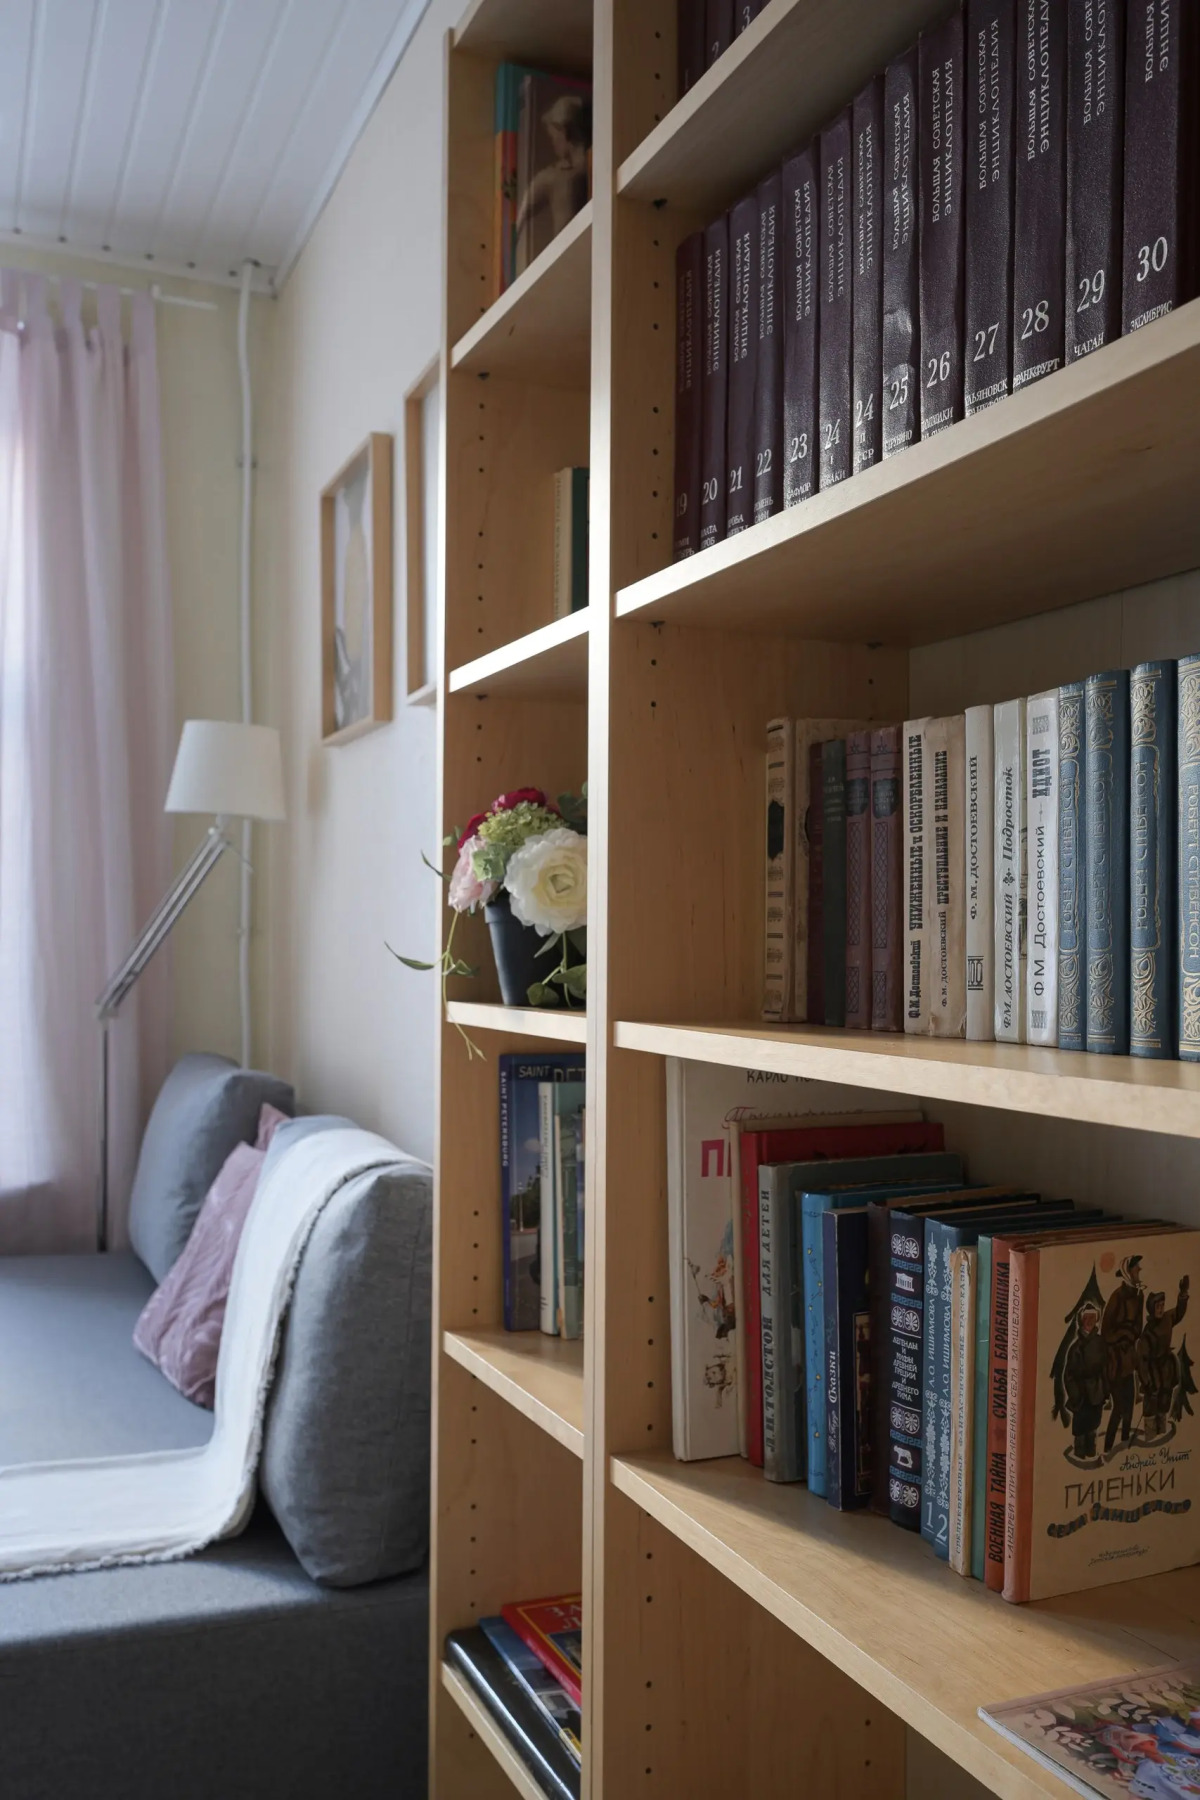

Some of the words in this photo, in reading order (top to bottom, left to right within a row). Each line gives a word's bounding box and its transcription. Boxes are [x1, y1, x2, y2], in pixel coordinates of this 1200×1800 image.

[978, 29, 987, 113] СОВЕТСКАЯ
[1145, 1, 1155, 83] БОЛЬШАЯ
[932, 67, 941, 149] СОВЕТСКАЯ
[990, 18, 1001, 182] ЭНЦИКЛОПЕДИЯ
[1083, 49, 1093, 125] БОЛЬШАЯ
[893, 102, 901, 181] СОВЕТСКАЯ
[944, 58, 953, 217] ЭНЦИКЛОПЕДИЯ
[978, 121, 988, 190] БОЛЬШАЯ
[1027, 88, 1036, 161] БОЛЬШАЯ
[858, 131, 866, 208] СОВЕТСКАЯ
[866, 122, 874, 269] ЭНЦИКЛОПЕДИЯ
[901, 92, 911, 245] ЭНЦИКЛОПЕДИЯ
[931, 156, 942, 223] БОЛЬШАЯ
[795, 189, 803, 258] СОВЕТСКАЯ
[827, 165, 835, 237] СОВЕТСКАЯ
[837, 157, 845, 297] ЭНЦИКЛОПЕДИЯ
[892, 187, 900, 251] БОЛЬШАЯ
[735, 238, 743, 304] СОВЕТСКАЯ
[760, 211, 768, 279] СОВЕТСКАЯ
[766, 205, 776, 335] ЭНЦИКЛОПЕДИЯ
[803, 181, 812, 317] ЭНЦИКЛОПЕДИЯ
[827, 243, 835, 303] БОЛЬШАЯ
[1136, 235, 1168, 281] 30
[712, 248, 721, 372] ЭНЦИКЛОПЕДИЯ
[740, 232, 751, 359] ЭНЦИКЛОПЕДИЯ
[1021, 300, 1050, 340] 28
[1076, 269, 1105, 313] 29
[926, 351, 950, 389] 26
[973, 323, 1000, 362] 27
[1074, 332, 1105, 357] ЧАГАН
[856, 393, 874, 428] 24
[890, 375, 909, 410] 25
[756, 449, 772, 478] 22
[790, 433, 808, 463] 23
[825, 419, 841, 450] 24
[703, 478, 718, 505] 20
[729, 466, 743, 493] 21
[908, 734, 923, 834] ОСКОРБЛЕННЫЕ
[935, 750, 948, 811] НАКАЗАНИЕ
[1031, 749, 1052, 799] ИДИОТ
[935, 814, 948, 823] И
[968, 755, 978, 879] ДОСТОЕВСКИЙ
[1002, 766, 1014, 862] Подросток
[1062, 776, 1074, 870] СТИВЕНСОН
[1134, 761, 1148, 862] СТИВЕНСОН
[1187, 784, 1199, 849] РОБЕРТ
[909, 846, 923, 931] УНИЖЕННЫЕ
[935, 826, 949, 905] ПРЕСТУПЛЕНИЕ
[1034, 825, 1047, 949] Достоевский
[969, 903, 978, 920] Ф.
[1062, 873, 1073, 933] РОБЕРТ
[1092, 872, 1105, 932] РОБЕРТ
[1135, 868, 1148, 930] РОБЕРТ
[1186, 855, 1199, 958] СТИВЕНСОН
[937, 911, 948, 984] ДОСТОЕВСКИЙ
[1003, 893, 1013, 999] ДОСТОЕВСКИЙ
[519, 1065, 551, 1079] SAINT
[501, 1102, 509, 1167] PETERSBURG
[762, 1259, 772, 1297] ДЛЯ
[959, 1263, 967, 1329] РАССКАЗЫ
[892, 1336, 918, 1350] ЛЕГЕНДЫ
[928, 1298, 936, 1361] ИШИМОВА
[942, 1305, 951, 1370] ИШИМОВА
[994, 1261, 1010, 1361] БАРАБАНЩИКА
[1010, 1284, 1020, 1361] ЗАМШЕЛОГО
[828, 1350, 837, 1404] Сказки
[891, 1381, 919, 1396] ДРЕВНЕГО
[892, 1359, 918, 1373] ДРЕВНЕЙ
[894, 1366, 916, 1381] ГРЕЦИИ
[896, 1352, 914, 1364] МИФЫ
[1010, 1367, 1018, 1398] СЕЛА
[957, 1334, 966, 1447] ФАНТАСТИЧЕСКИЕ
[992, 1368, 1008, 1419] СУДЬБА
[1009, 1402, 1018, 1461] ПАРЕНЬКИ
[1119, 1453, 1157, 1472] Андрей
[1158, 1446, 1192, 1466] Упит
[955, 1453, 964, 1554] СРЕДНЕВЕКОВЫЕ
[989, 1452, 1007, 1494] ТАЙНА
[1064, 1467, 1175, 1509] ПАРЕНЬКИ
[926, 1501, 934, 1528] 1
[936, 1513, 948, 1542] 2
[988, 1501, 1004, 1564] ВОЕННАЯ
[1006, 1503, 1015, 1552] АНДРЕЙ
[1046, 1513, 1088, 1539] СЕЛА
[1090, 1501, 1192, 1523] ЗАМШЕЛОГО
